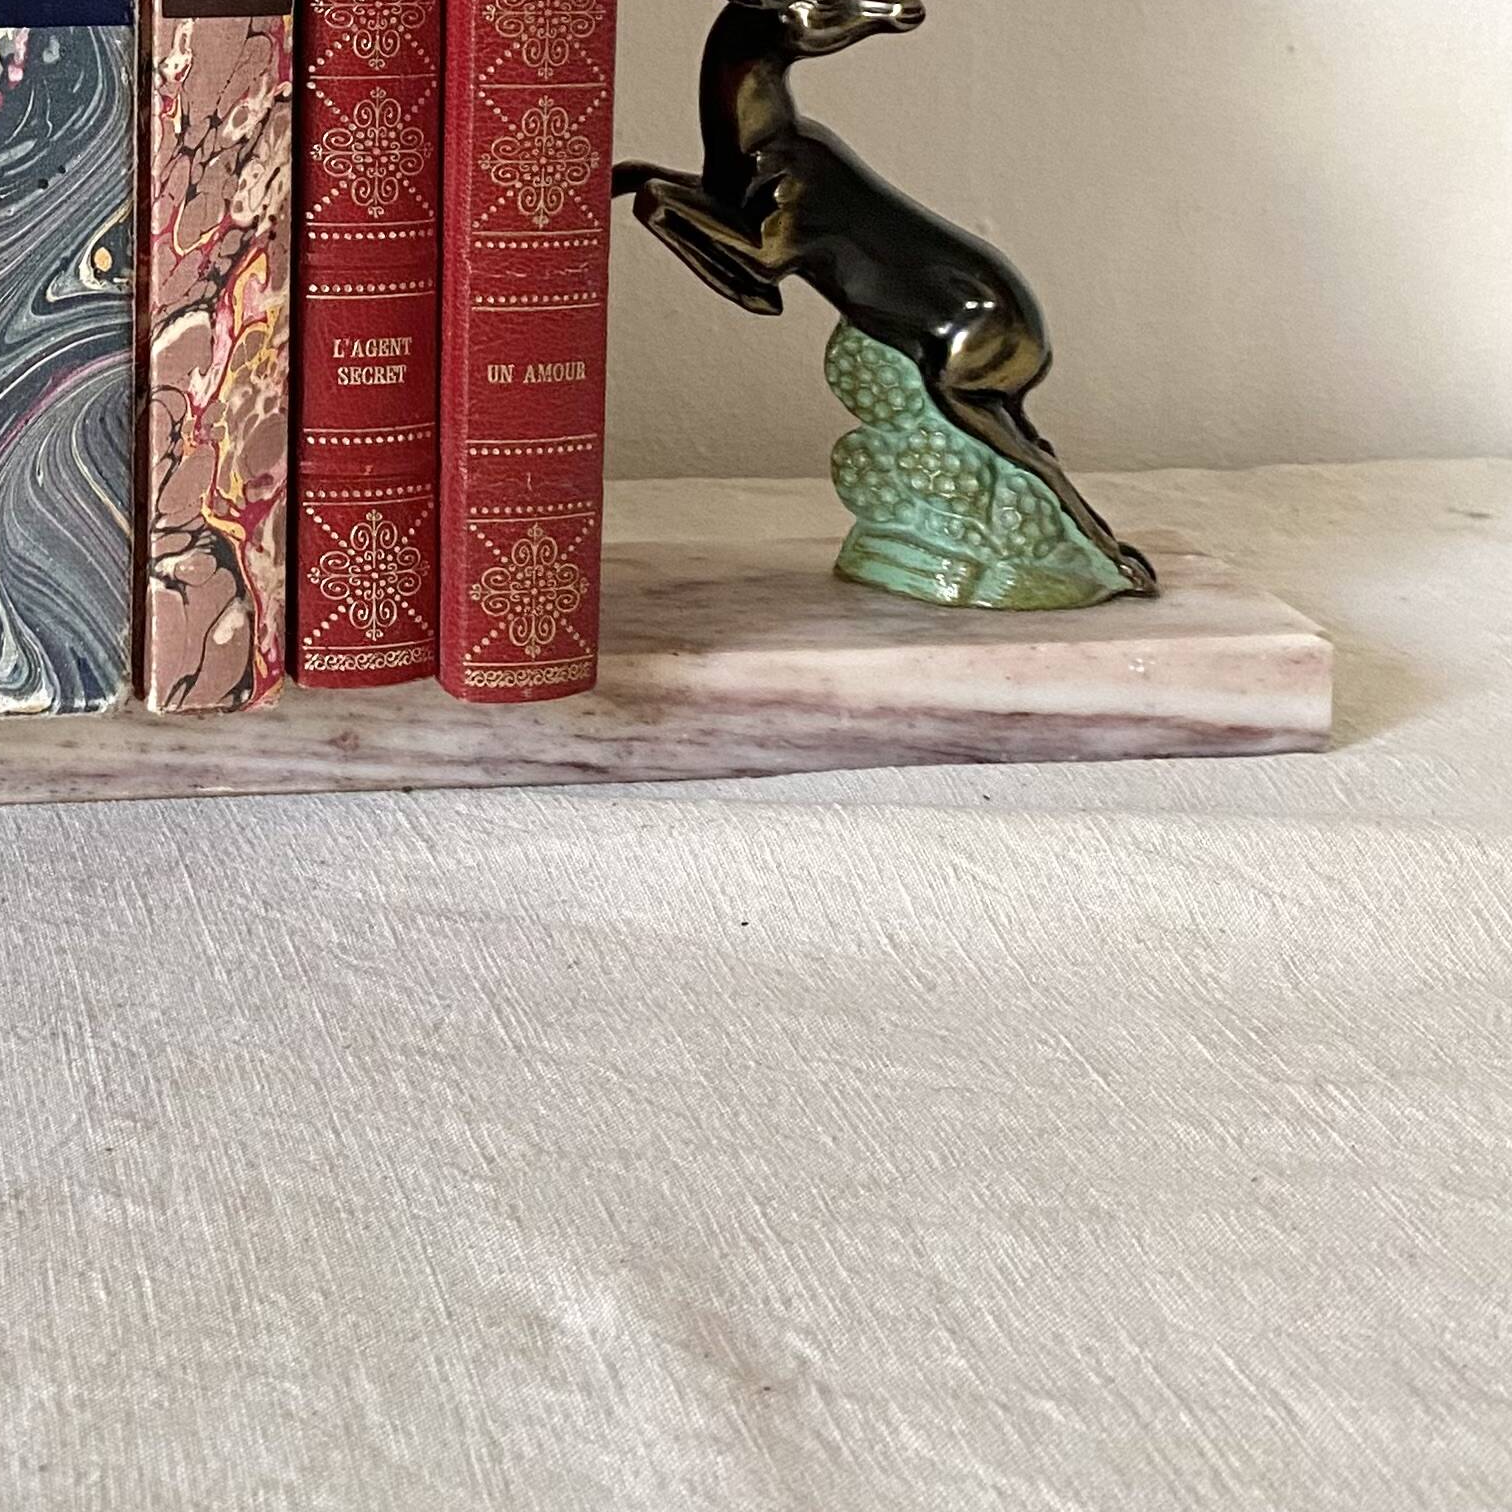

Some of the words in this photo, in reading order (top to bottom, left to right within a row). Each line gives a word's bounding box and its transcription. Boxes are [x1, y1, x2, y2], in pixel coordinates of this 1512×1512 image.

[333, 337, 413, 359] L'AGENT
[337, 364, 407, 386] SECRET
[488, 364, 515, 384] UN
[523, 361, 587, 385] AMOUR
